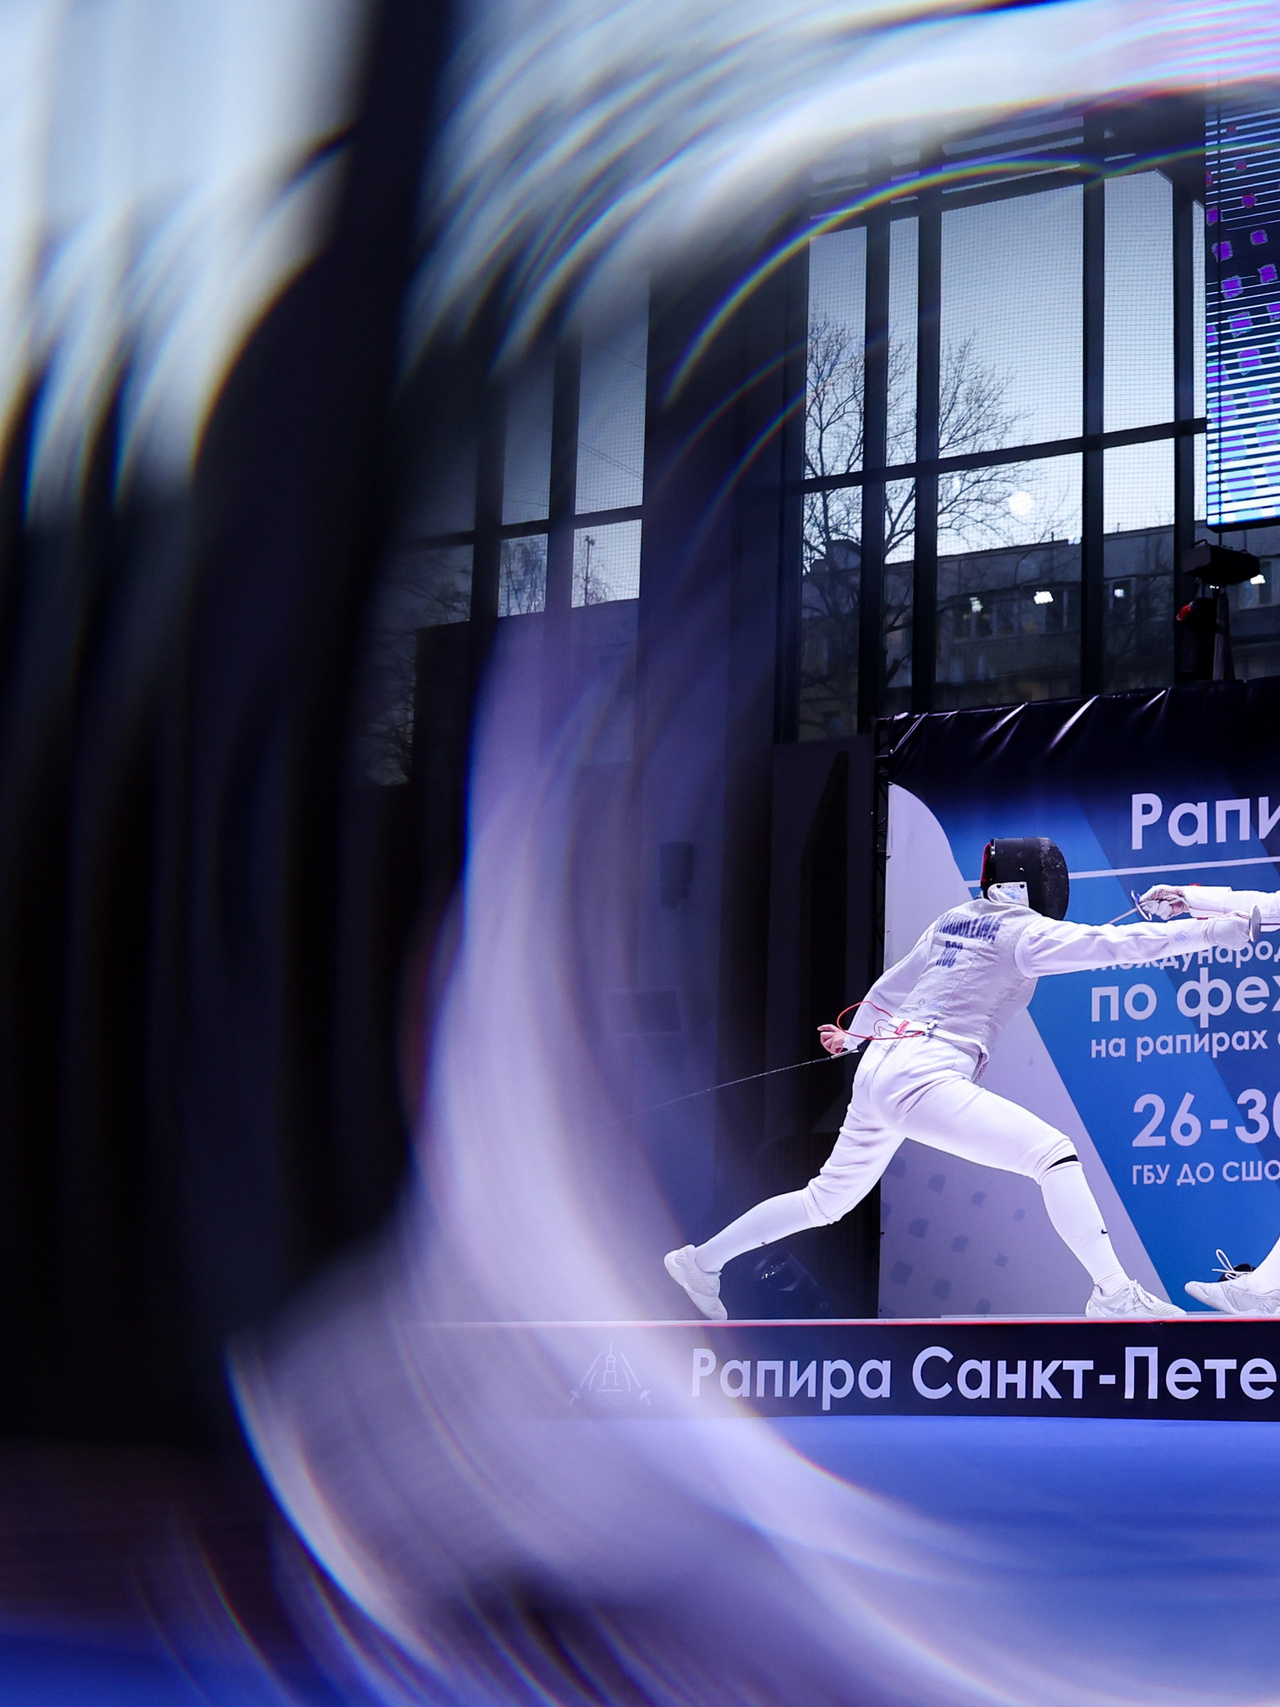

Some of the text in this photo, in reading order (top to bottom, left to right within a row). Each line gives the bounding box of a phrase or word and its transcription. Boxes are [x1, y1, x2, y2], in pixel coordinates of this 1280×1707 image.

[1090, 982, 1158, 1023] по
[1090, 1036, 1126, 1059] на
[1135, 1028, 1268, 1063] рапирах
[1132, 1164, 1170, 1185] ГБУ
[1176, 1162, 1215, 1186] ДО
[690, 1346, 892, 1411] Рапира
